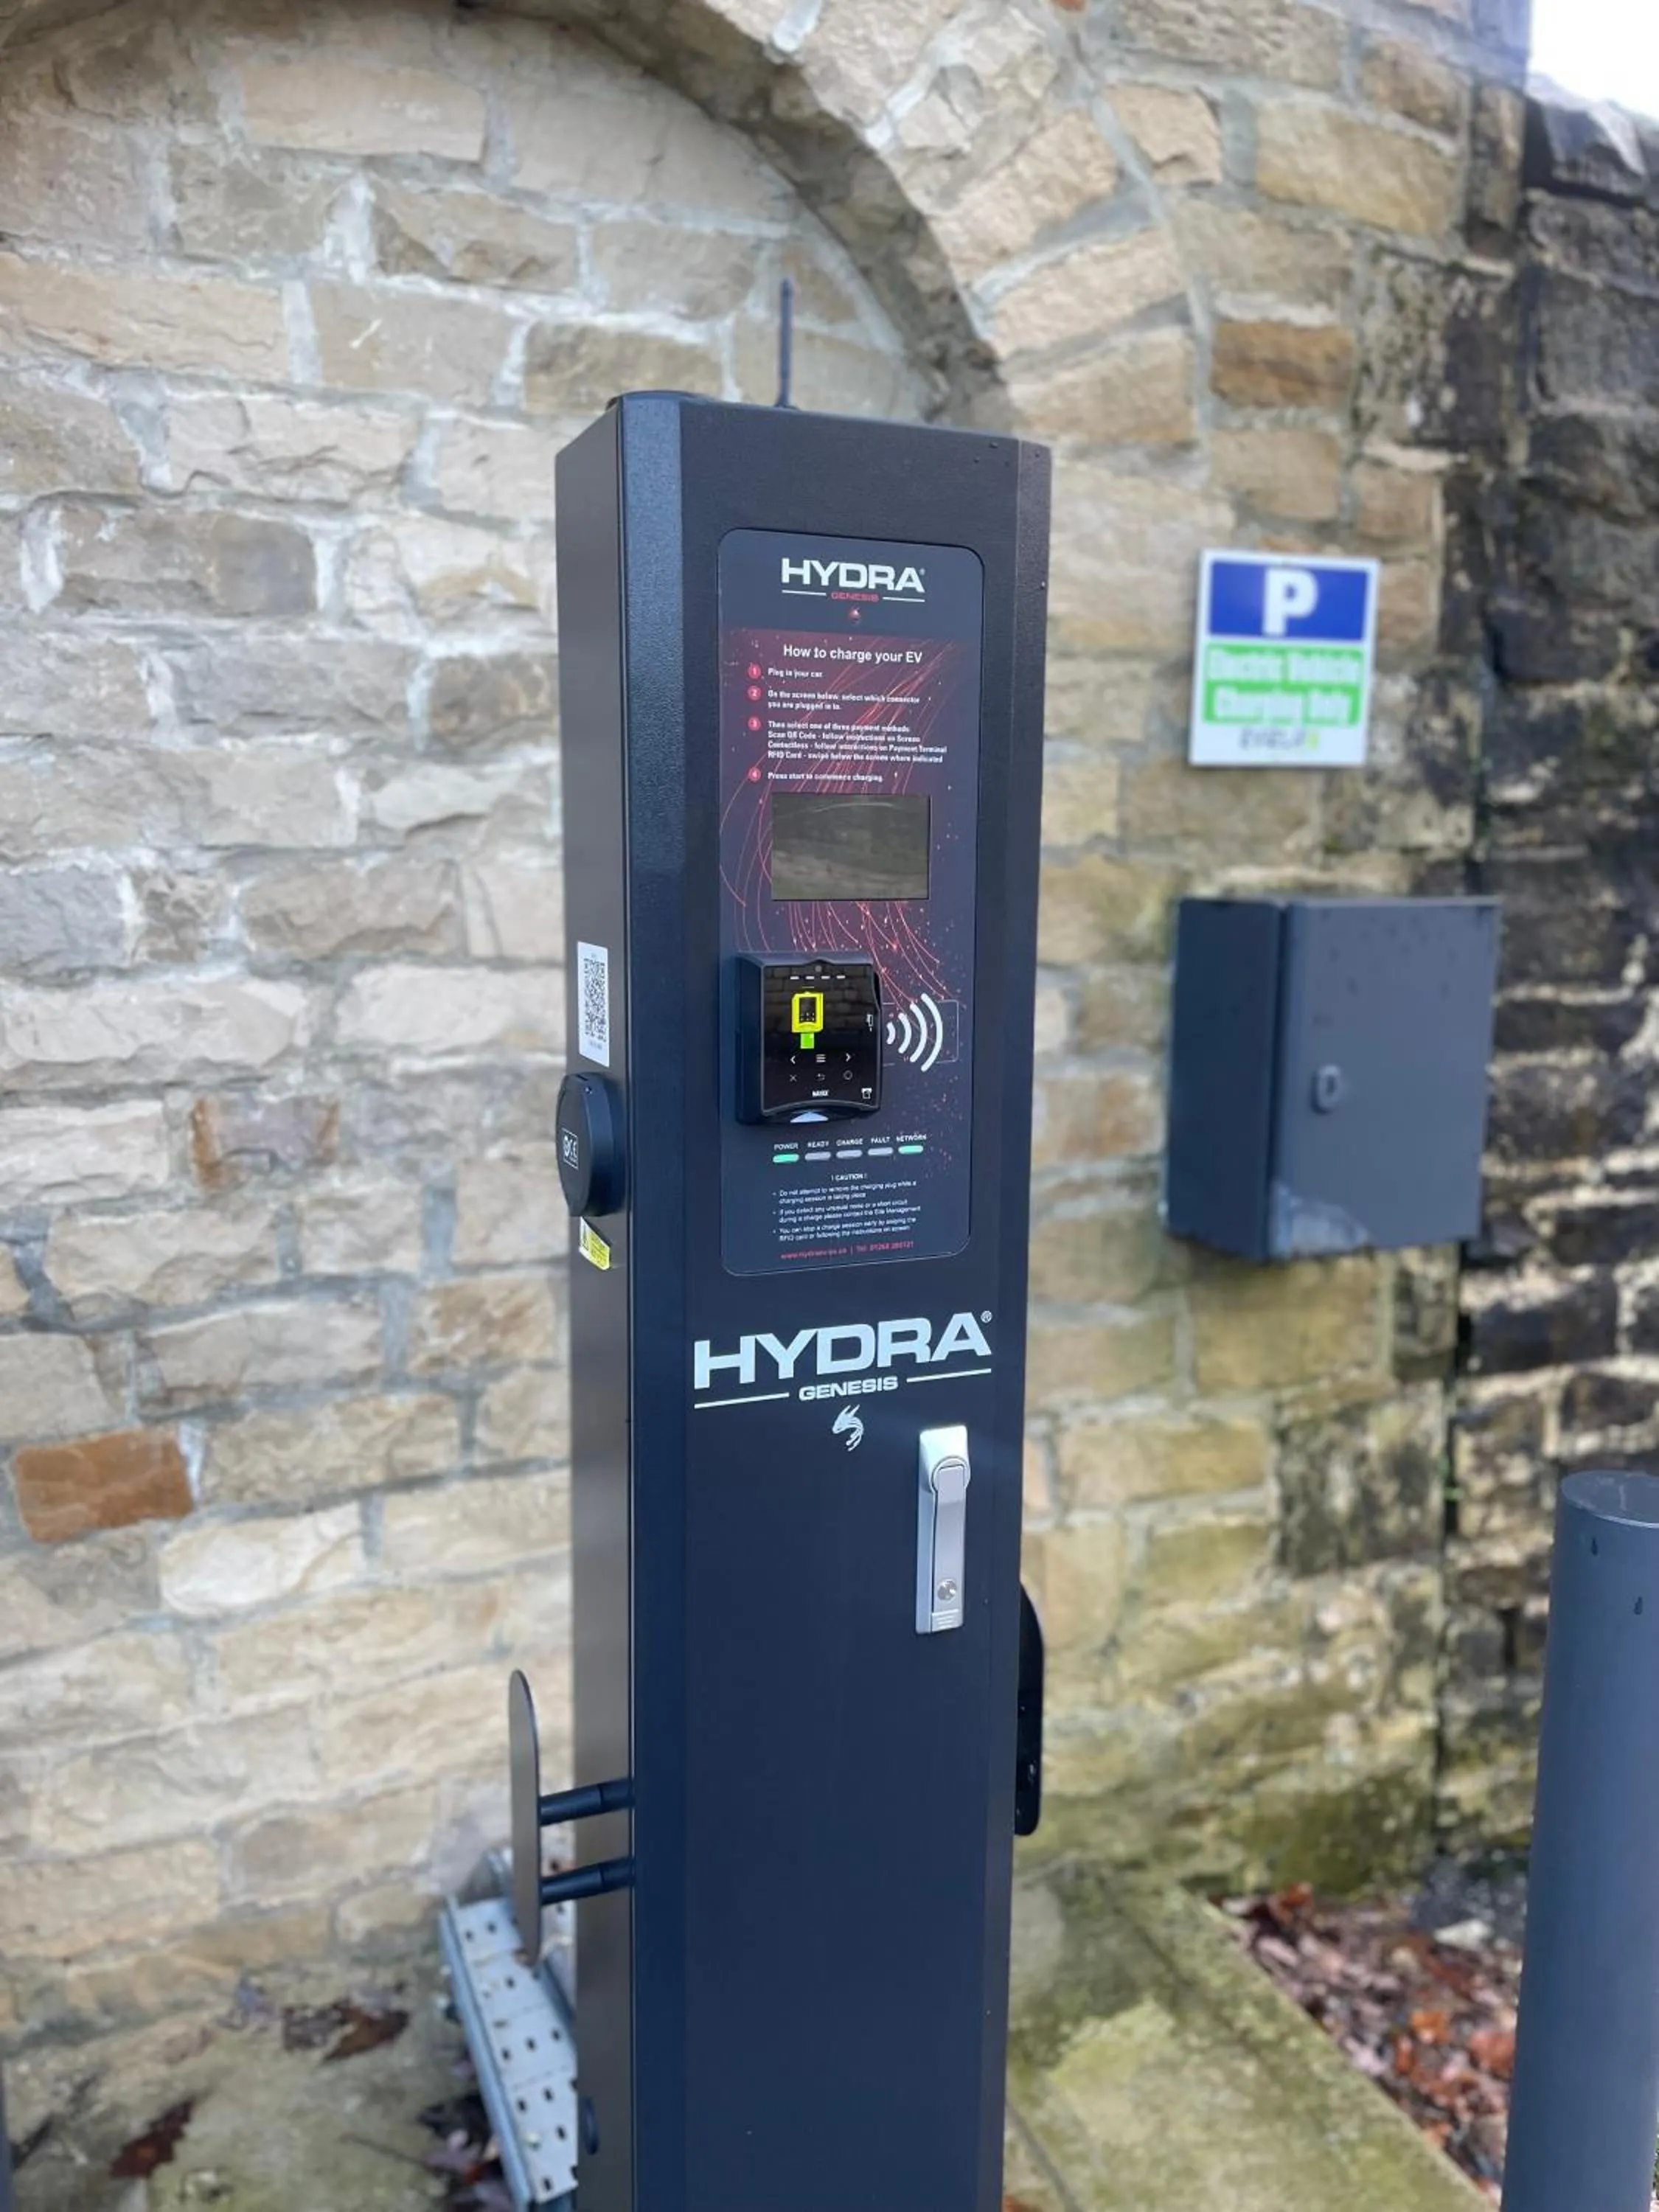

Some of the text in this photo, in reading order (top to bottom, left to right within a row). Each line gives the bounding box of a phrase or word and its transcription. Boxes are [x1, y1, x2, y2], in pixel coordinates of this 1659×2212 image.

[782, 557, 925, 593] HYDRA
[831, 591, 880, 602] GENESIS
[1263, 567, 1318, 637] P
[783, 644, 922, 664] How to charge your EV
[768, 667, 784, 678] Plug
[785, 669, 793, 677] in
[793, 669, 810, 679] your
[768, 689, 778, 698] On
[779, 691, 790, 699] the
[841, 693, 863, 701] select
[863, 694, 886, 703] which
[886, 696, 920, 704] connector
[768, 701, 782, 709] you
[795, 701, 824, 712] plugged
[768, 720, 785, 728] Then
[787, 722, 809, 730] select
[832, 723, 850, 731] three
[851, 724, 880, 733] payment
[768, 731, 786, 739] Scan
[787, 731, 797, 739] QR
[799, 731, 816, 740] Code
[822, 732, 844, 740] follow
[768, 740, 809, 749] Contactless
[814, 742, 837, 750] follow
[888, 744, 918, 754] Payment
[919, 744, 947, 753] Terminal
[768, 751, 785, 759] RFID
[808, 752, 829, 761] swipe
[830, 753, 853, 761] below
[768, 772, 787, 780] Press
[773, 1133, 927, 1151] POWER READY CHARGE FAULT NETWORK
[835, 1172, 863, 1182] CAUTION
[788, 1188, 799, 1196] not
[799, 1186, 821, 1196] attempt
[828, 1185, 849, 1193] remove
[850, 1183, 859, 1192] the
[860, 1182, 884, 1192] charging
[884, 1180, 897, 1190] plug
[779, 1197, 804, 1206] charging
[804, 1194, 827, 1203] session
[833, 1192, 850, 1201] taking
[779, 1215, 797, 1224] during
[803, 1213, 823, 1222] charge
[824, 1212, 842, 1221] please
[784, 1209, 796, 1217] you
[791, 1225, 802, 1234] can
[694, 1311, 992, 1390] HYDRA
[799, 1376, 898, 1401] GENESIS
